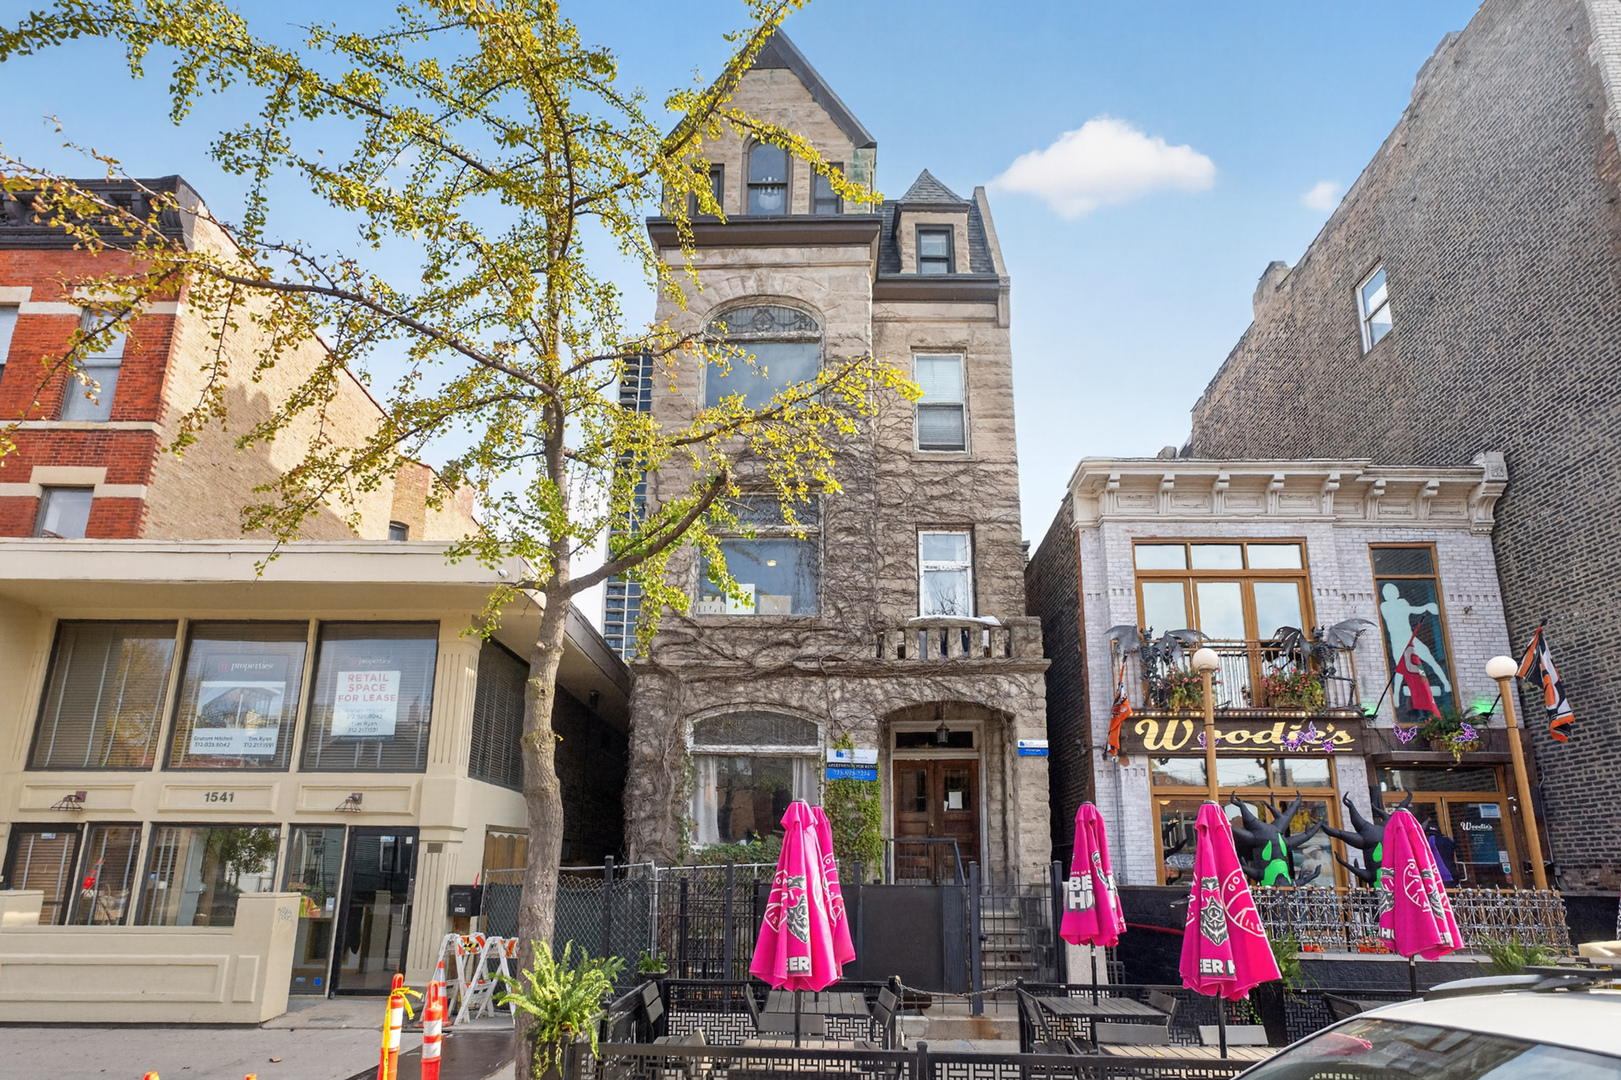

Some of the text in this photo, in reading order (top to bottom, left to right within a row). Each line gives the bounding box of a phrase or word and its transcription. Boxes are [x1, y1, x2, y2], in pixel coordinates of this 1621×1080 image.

[347, 673, 389, 682] RETAIL
[348, 683, 387, 692] SPACE
[338, 694, 396, 702] FOR LEASE
[1135, 719, 1356, 750] Wodie's
[204, 791, 235, 803] 1541
